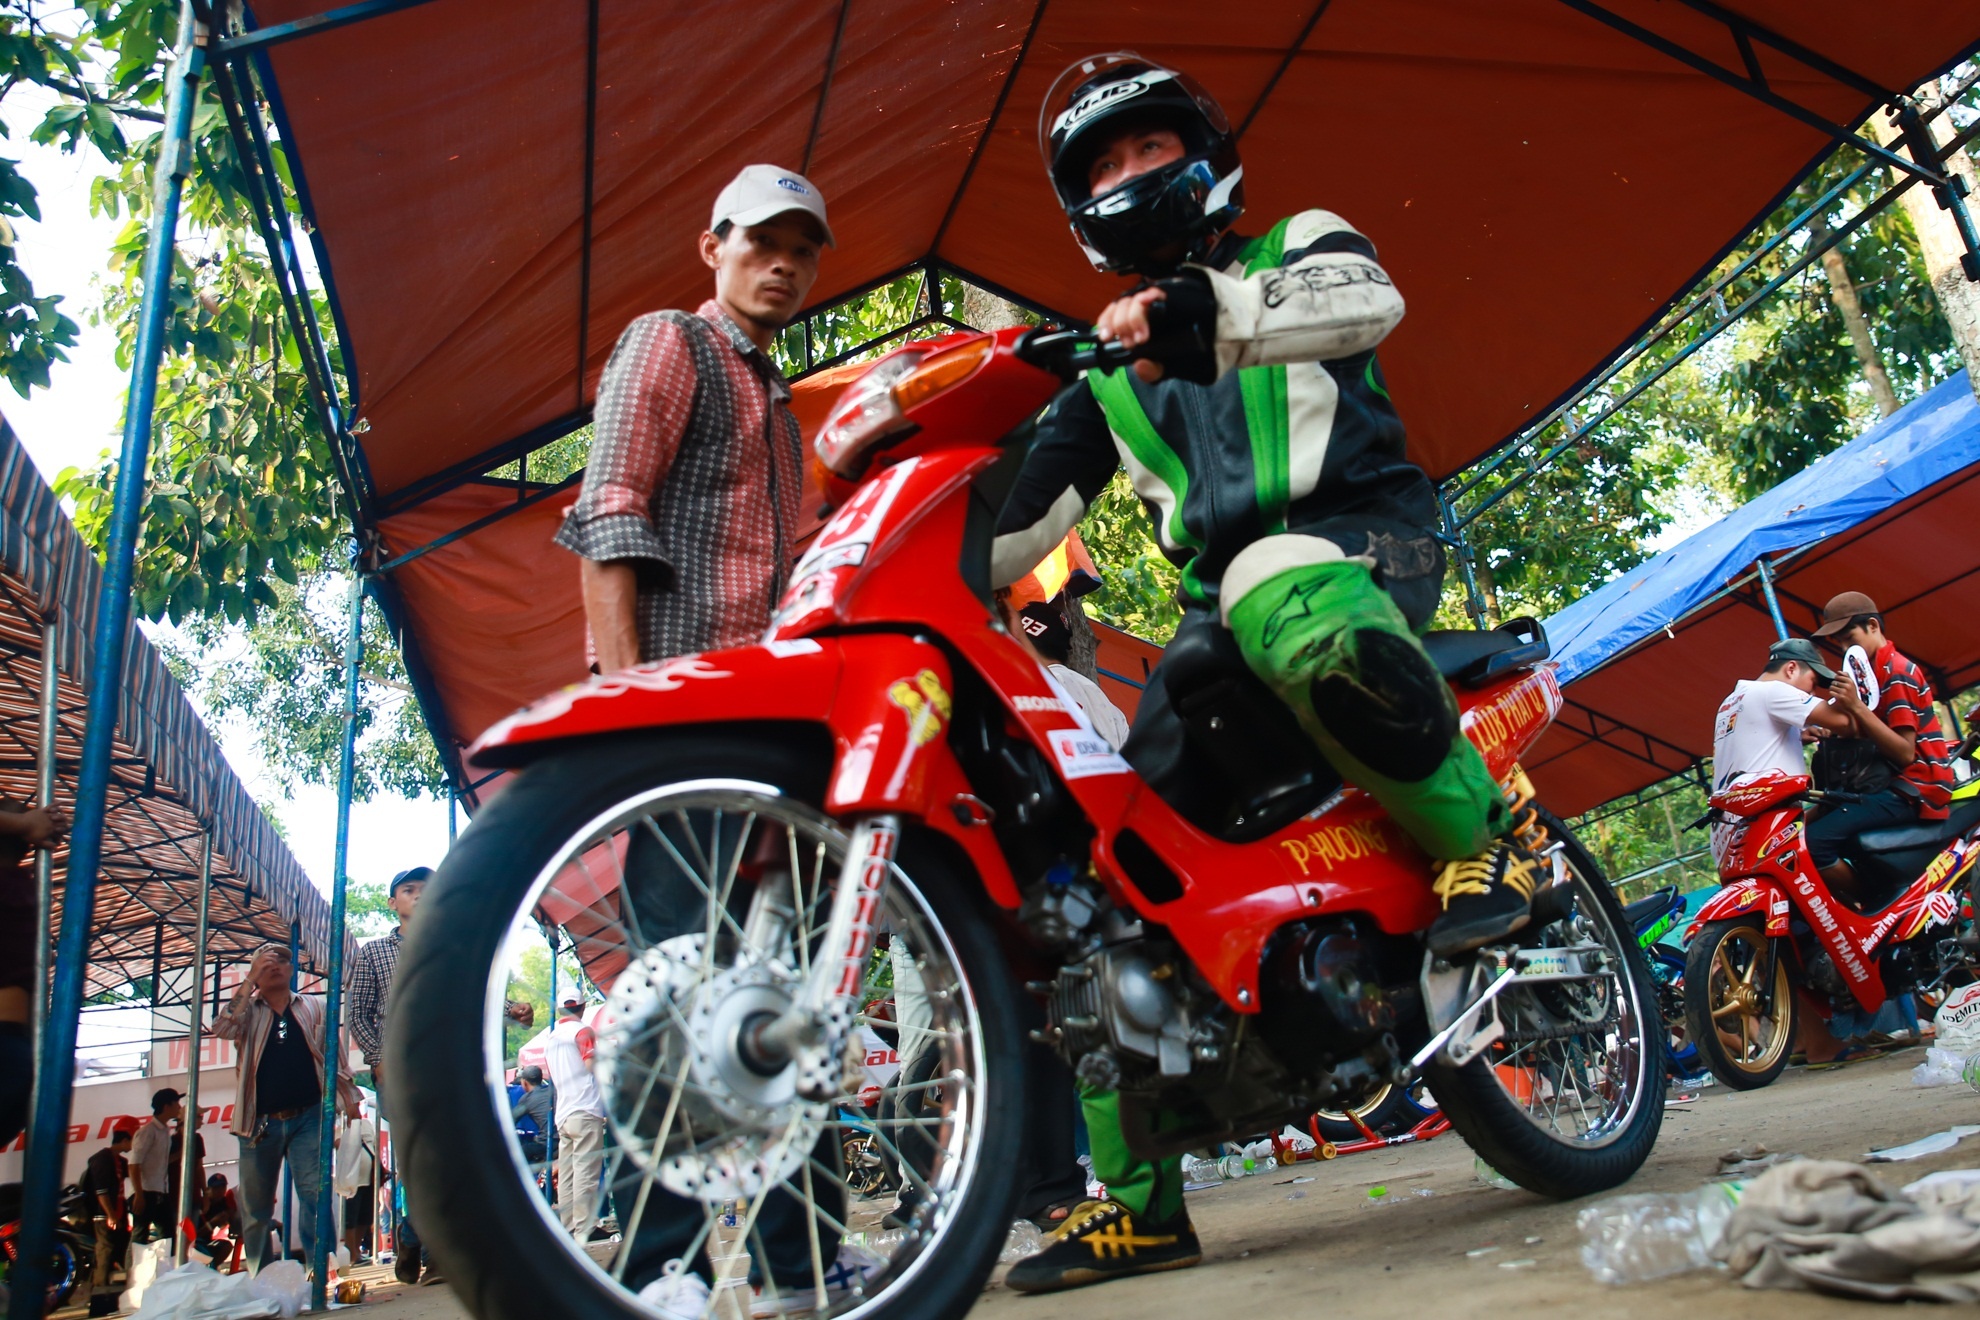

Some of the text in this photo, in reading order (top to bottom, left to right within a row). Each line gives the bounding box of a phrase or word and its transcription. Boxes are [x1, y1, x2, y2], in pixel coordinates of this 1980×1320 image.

[1021, 616, 1048, 637] 93
[1473, 703, 1508, 753] LUB
[1931, 895, 1953, 919] 02
